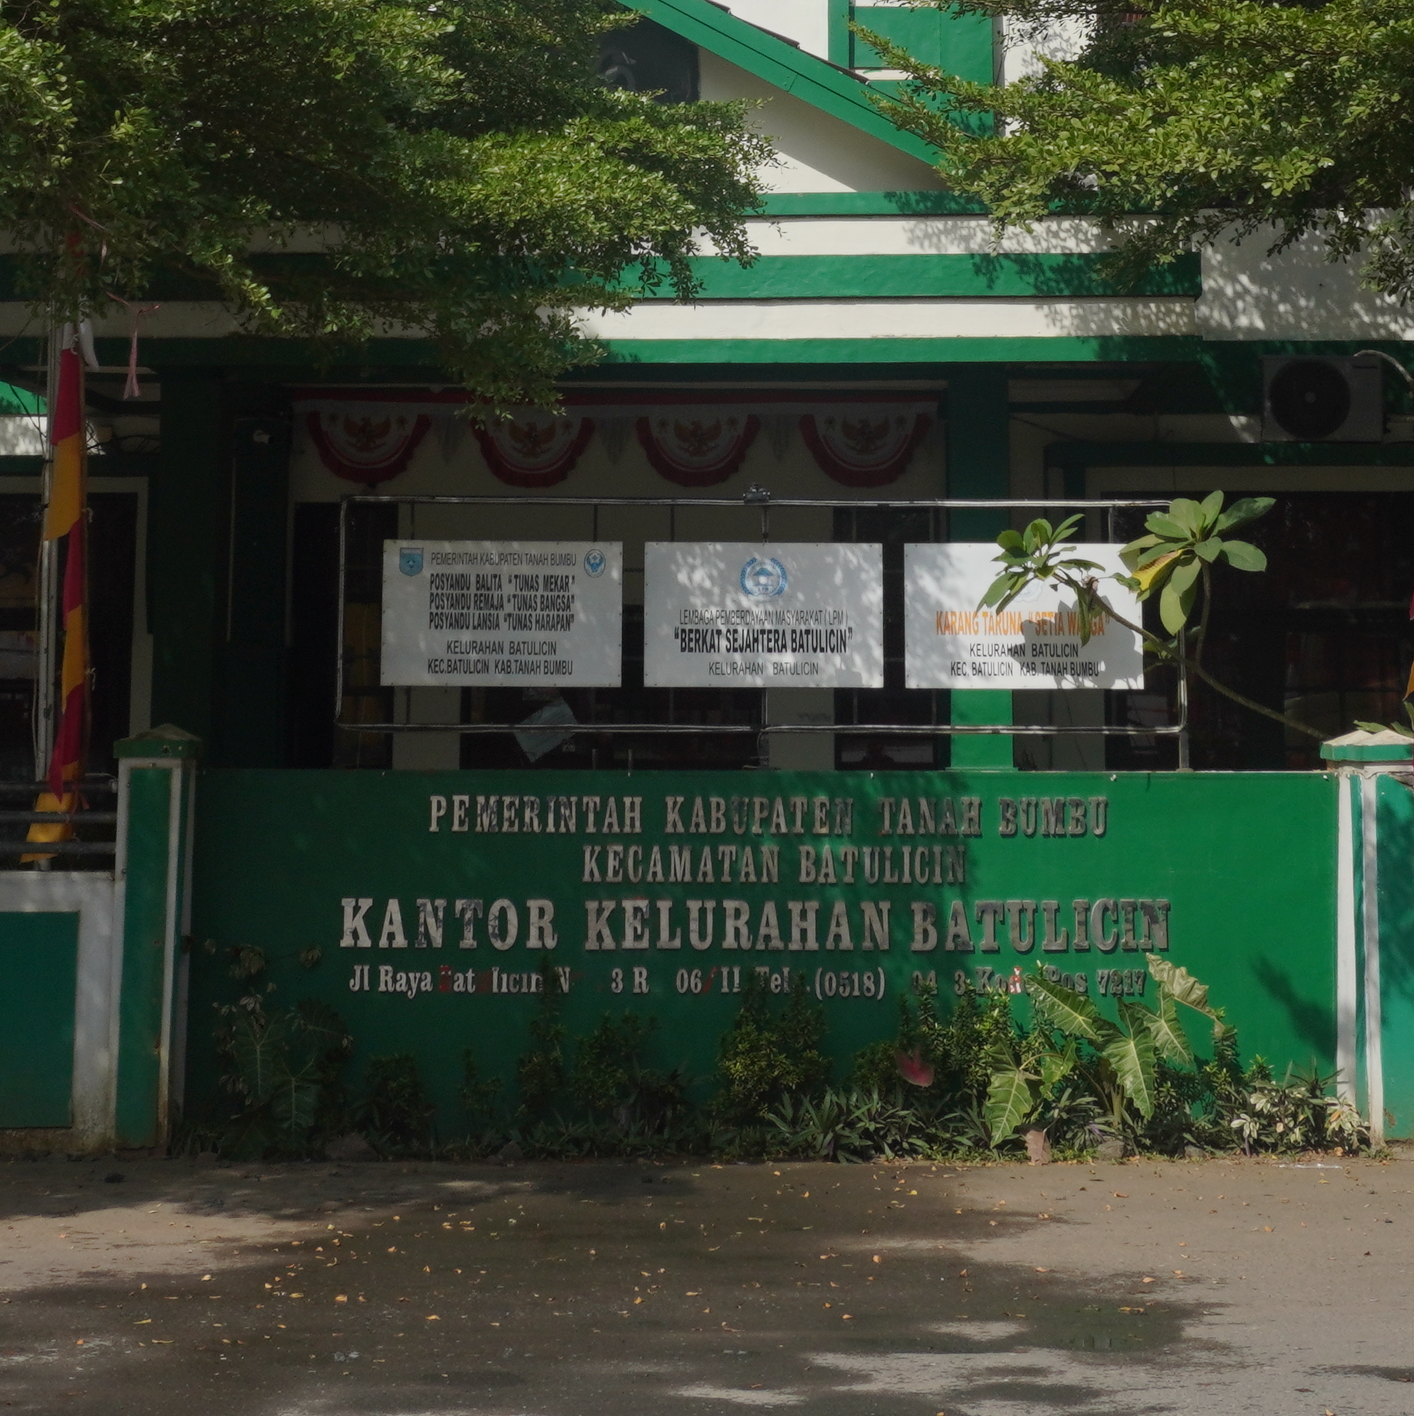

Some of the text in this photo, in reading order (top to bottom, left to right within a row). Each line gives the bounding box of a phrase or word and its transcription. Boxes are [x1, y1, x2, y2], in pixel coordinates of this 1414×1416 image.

[431, 553, 576, 566] PEMERINTAH KABUPATEN TANAH BUMBU
[430, 573, 470, 591] POSYANDU
[476, 574, 502, 591] BALITA
[429, 593, 471, 610] POSYANDU
[473, 594, 504, 610] REMAJA
[429, 612, 471, 630] POSYANDU
[472, 613, 500, 630] LANSIA
[680, 610, 714, 625] LEMBAGA
[715, 610, 774, 625] PEMBERDAYAAN
[775, 610, 823, 625] MASYARAKAT
[936, 611, 979, 635] KARANG
[982, 611, 1023, 635] TARUNA
[447, 641, 557, 655] KELURAHAN BATULICIN
[725, 629, 788, 653] SEJAHTERA
[969, 644, 1079, 658] KELURAHAN BATULICIN
[543, 660, 573, 675] BUMBU
[709, 662, 819, 675] KELURAHAN BATULICIN
[950, 662, 970, 677] KEC.
[972, 662, 1013, 677] BATULICIN
[1040, 662, 1069, 677] TANAH
[1070, 662, 1100, 677] BUMBU
[429, 794, 1108, 838] PEMERINTAH KABUPATEN TANAH BUMBU
[582, 844, 966, 885] KECAMATAN BATULICIN
[339, 897, 1171, 953] KANTOR KELURAHAN BATULICIN
[378, 965, 434, 999] Raya
[815, 966, 886, 1001] (0518)
